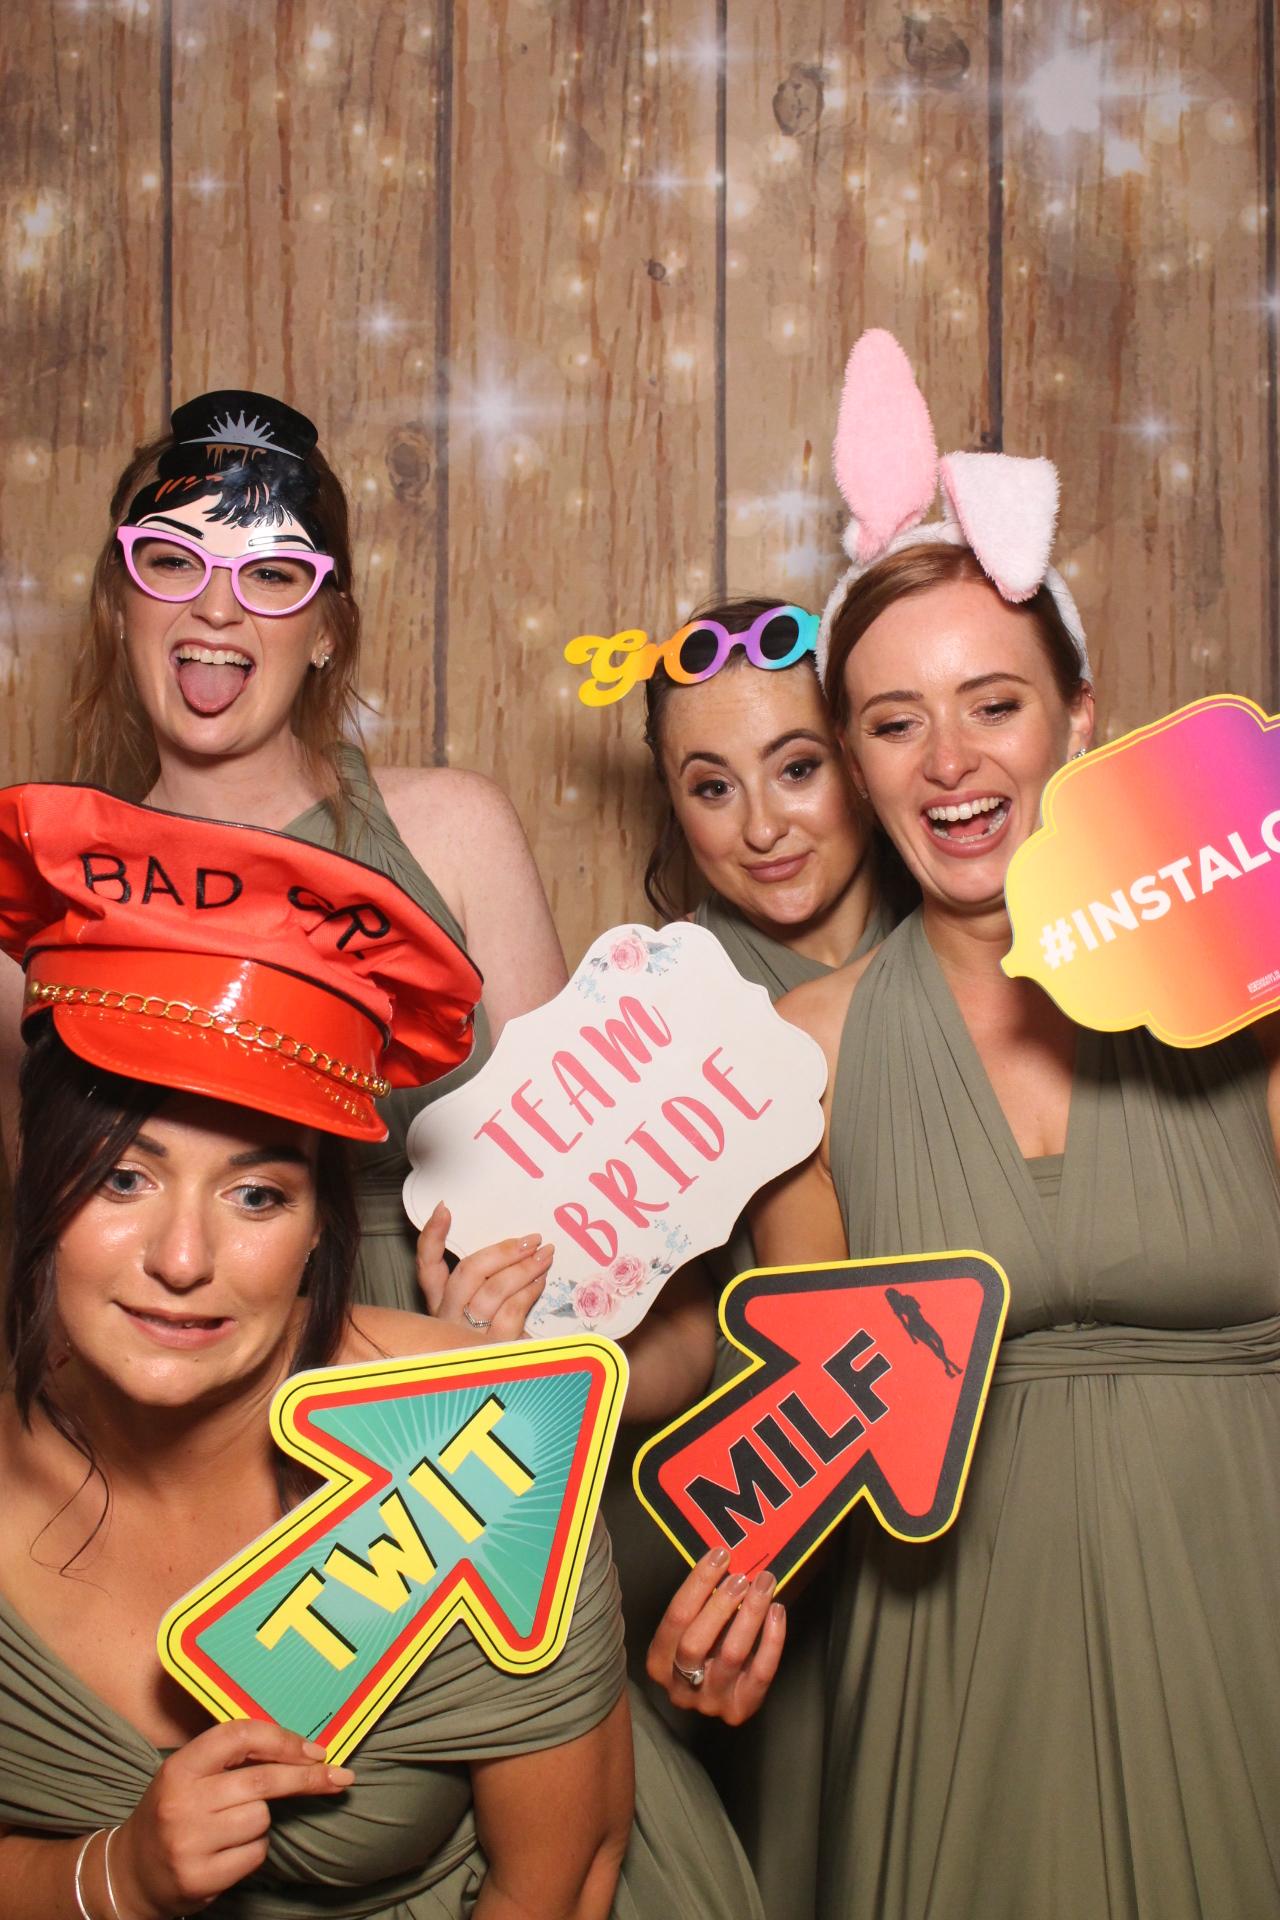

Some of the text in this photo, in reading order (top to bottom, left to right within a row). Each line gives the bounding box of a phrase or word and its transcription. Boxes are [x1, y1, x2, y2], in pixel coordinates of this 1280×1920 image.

[79, 852, 244, 910] BAD
[474, 996, 672, 1179] TEAM
[554, 1047, 773, 1267] BRIDE
[255, 1392, 536, 1671] TWIT
[684, 1328, 892, 1550] MILF
